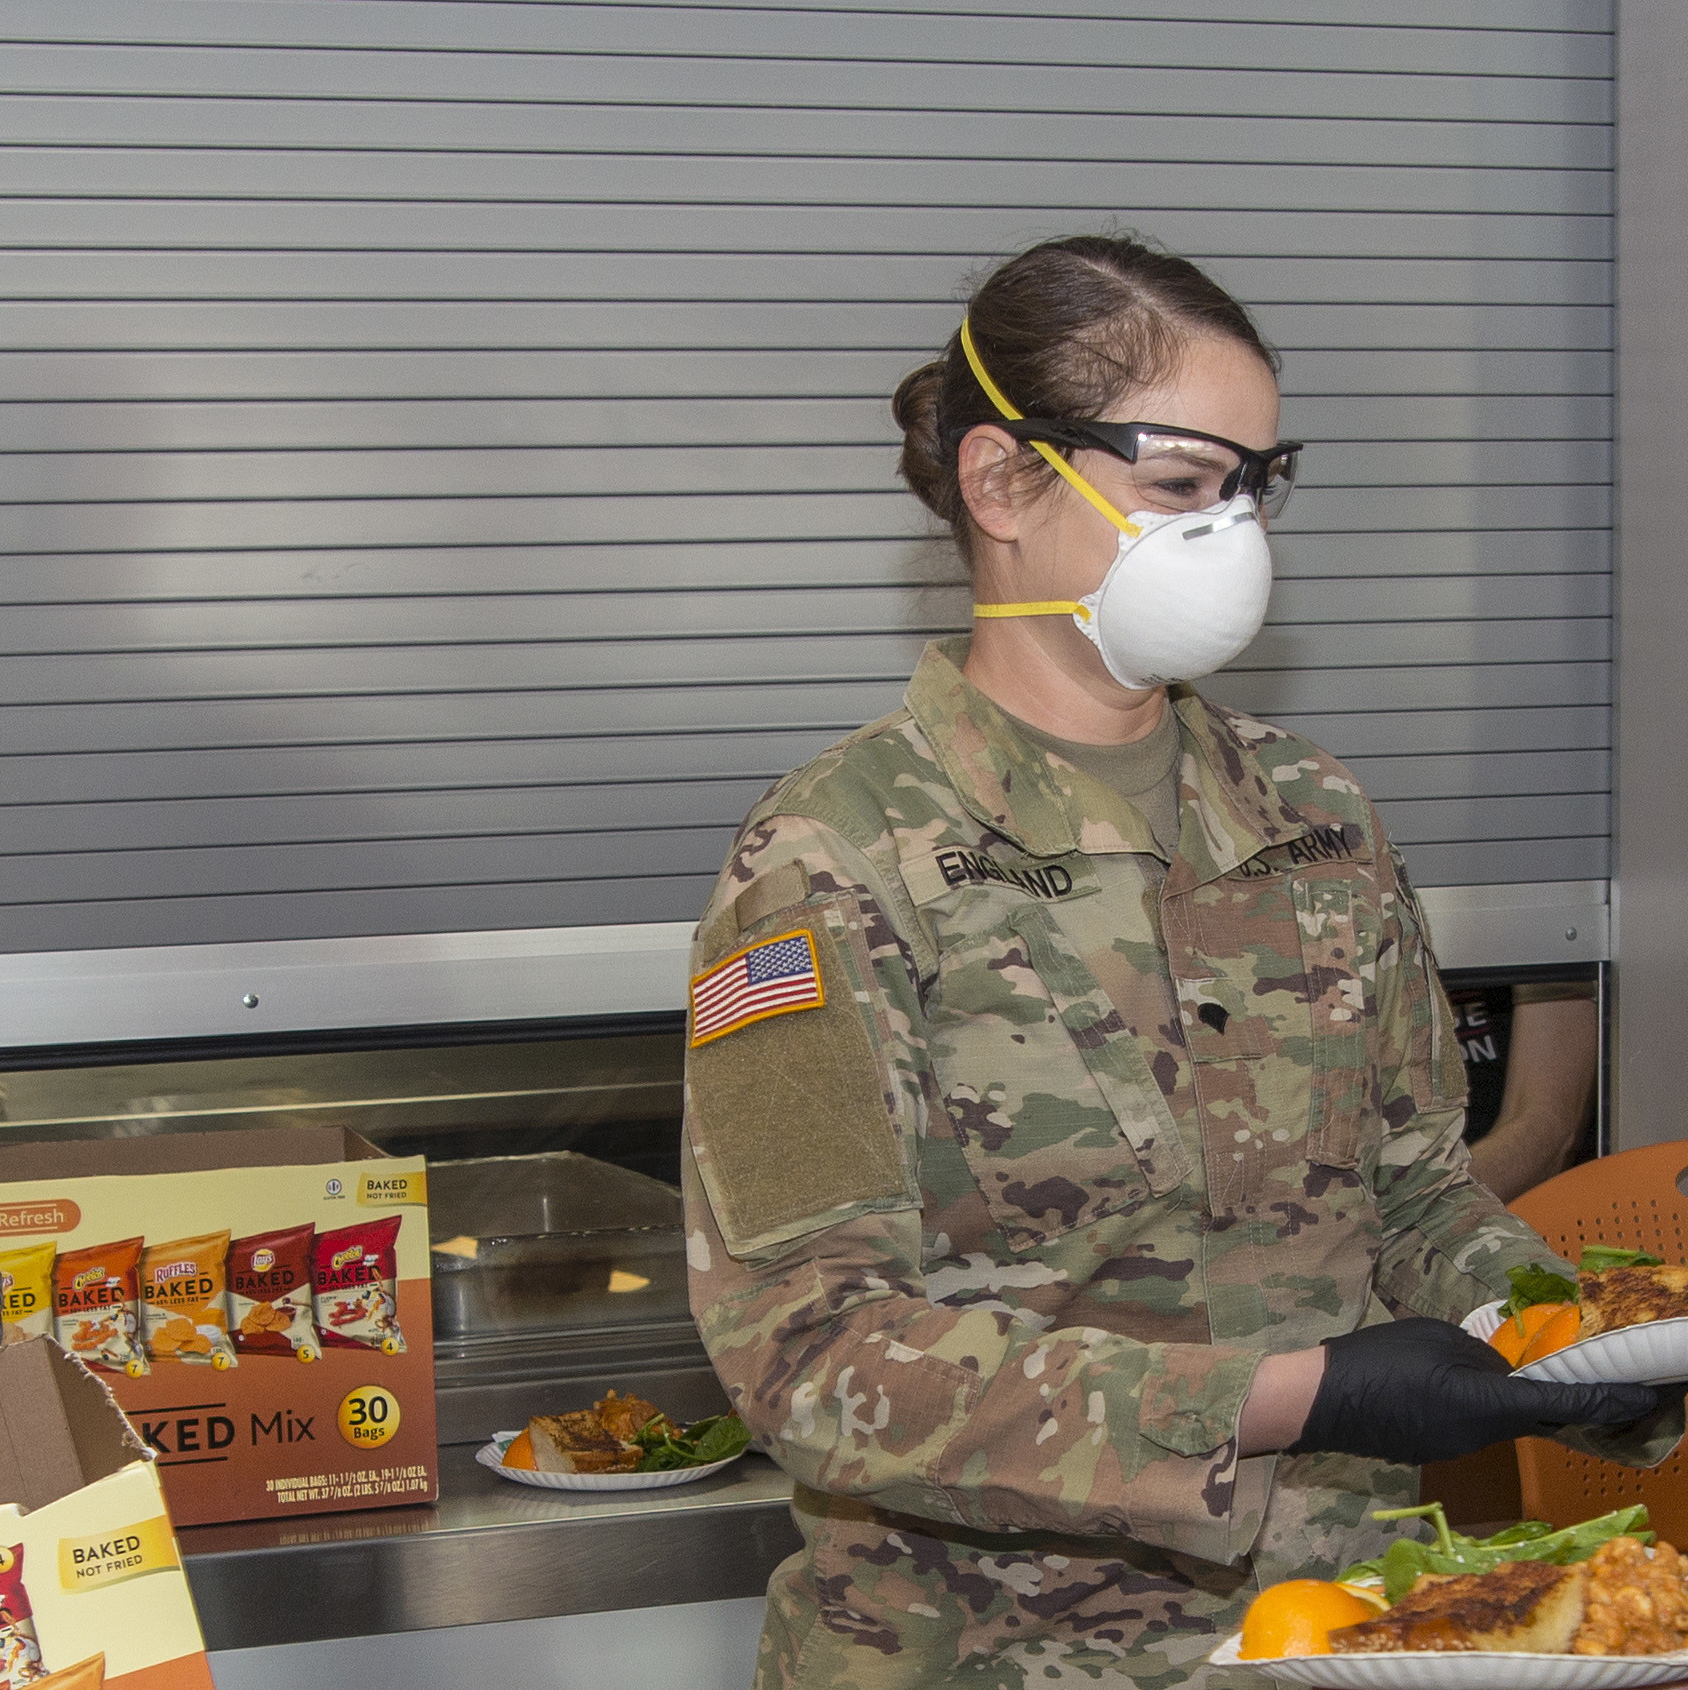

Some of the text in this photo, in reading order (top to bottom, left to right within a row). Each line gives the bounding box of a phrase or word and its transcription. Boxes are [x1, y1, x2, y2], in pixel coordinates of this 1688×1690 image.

[1287, 826, 1353, 865] ARMY
[367, 1179, 407, 1190] BAKED
[367, 1192, 381, 1200] NOT
[155, 1263, 197, 1284] RUFFLES
[235, 1270, 295, 1290] BAKED
[317, 1264, 381, 1286] BAKED
[58, 1286, 125, 1308] BAKED
[145, 1278, 213, 1300] BAKED
[303, 1348, 309, 1360] 5
[386, 1341, 394, 1352] 4
[219, 1356, 225, 1368] 7
[348, 1396, 389, 1426] 30
[141, 1409, 315, 1454] KED Mix
[353, 1426, 385, 1440] Bags
[277, 1490, 295, 1504] TOTAL
[297, 1488, 308, 1502] NET
[73, 1536, 141, 1564] BAKED
[76, 1554, 143, 1578] NOT FRIED
